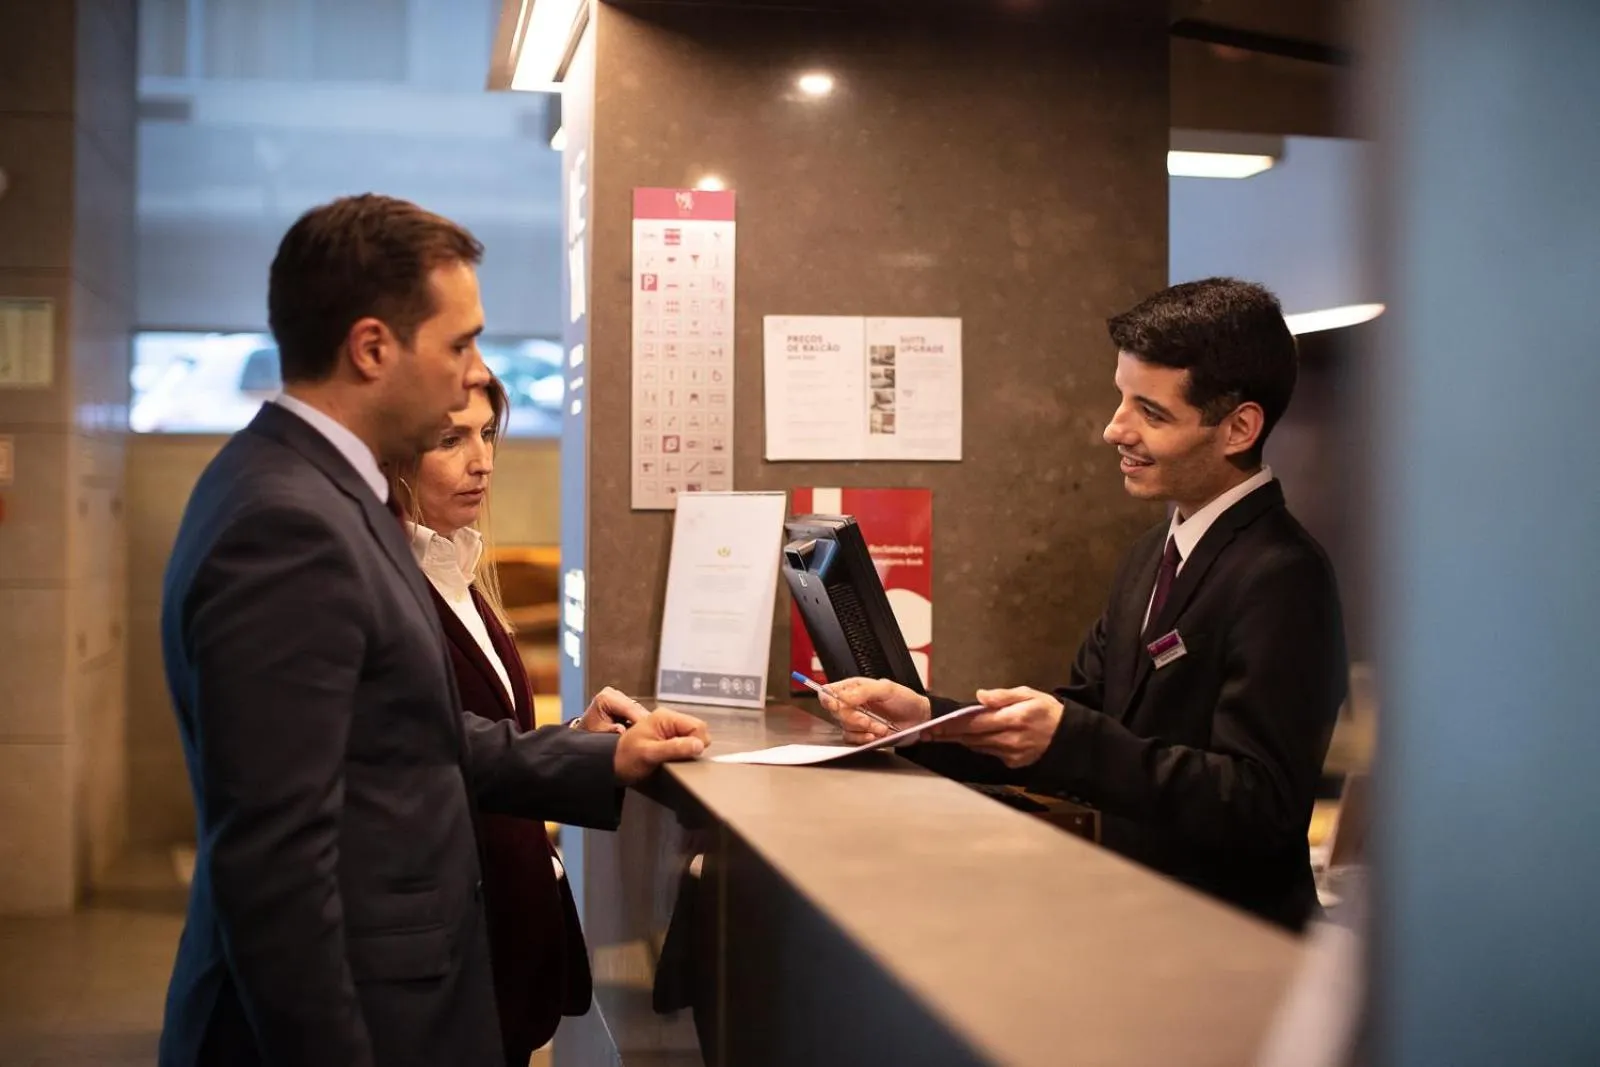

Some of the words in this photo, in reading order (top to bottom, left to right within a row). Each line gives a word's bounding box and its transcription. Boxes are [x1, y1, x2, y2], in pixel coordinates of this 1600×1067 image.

[787, 335, 823, 344] PREÇOS
[787, 344, 799, 352] DE
[802, 342, 841, 352] BALCÃO
[900, 345, 944, 353] UPGRADE
